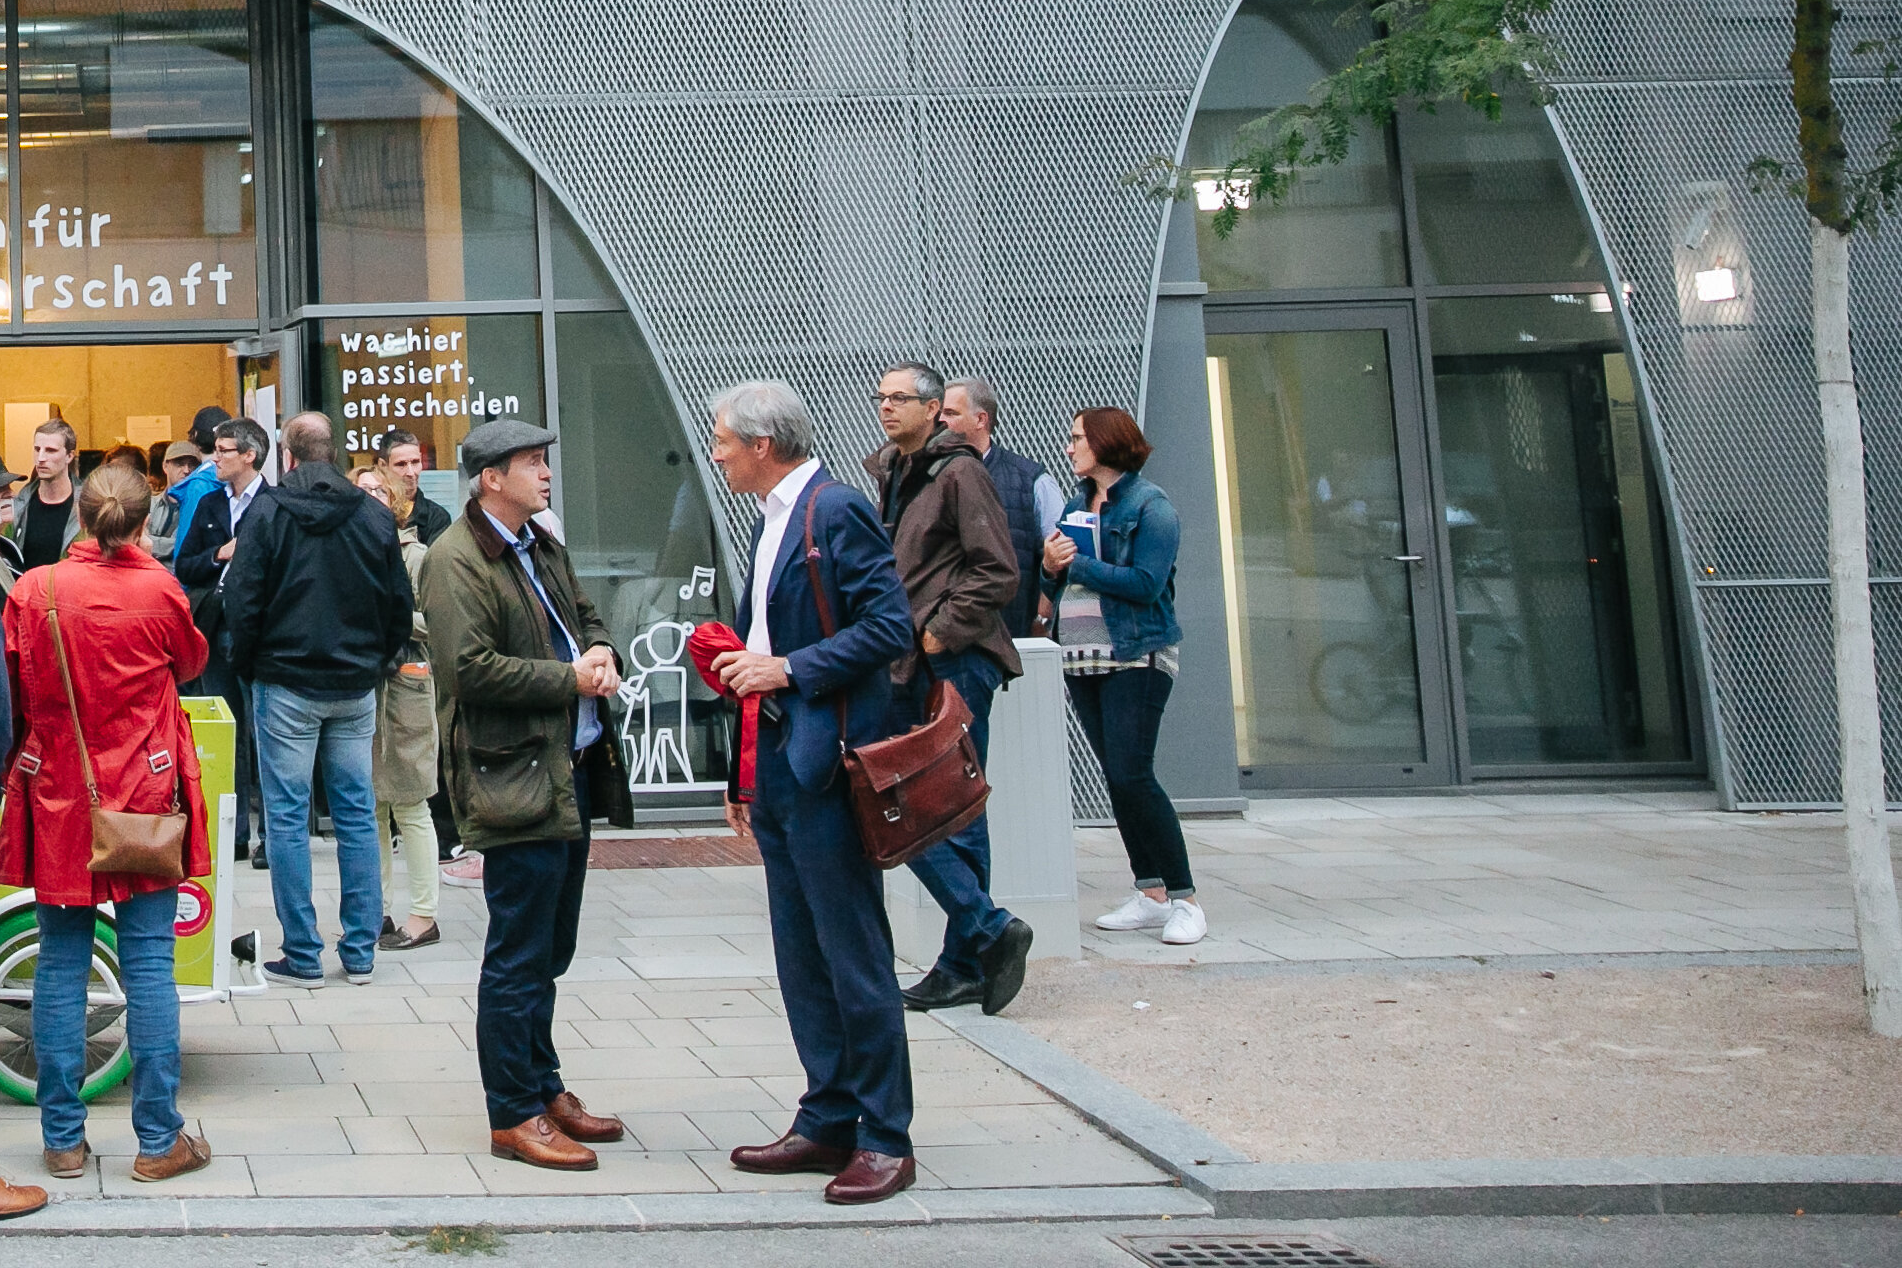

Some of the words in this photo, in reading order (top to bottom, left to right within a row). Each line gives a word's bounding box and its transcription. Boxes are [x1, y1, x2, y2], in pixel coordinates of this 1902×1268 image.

[27, 204, 112, 248] für
[406, 327, 463, 352] hier
[343, 359, 475, 394] passiert,
[343, 390, 520, 419] entscheiden
